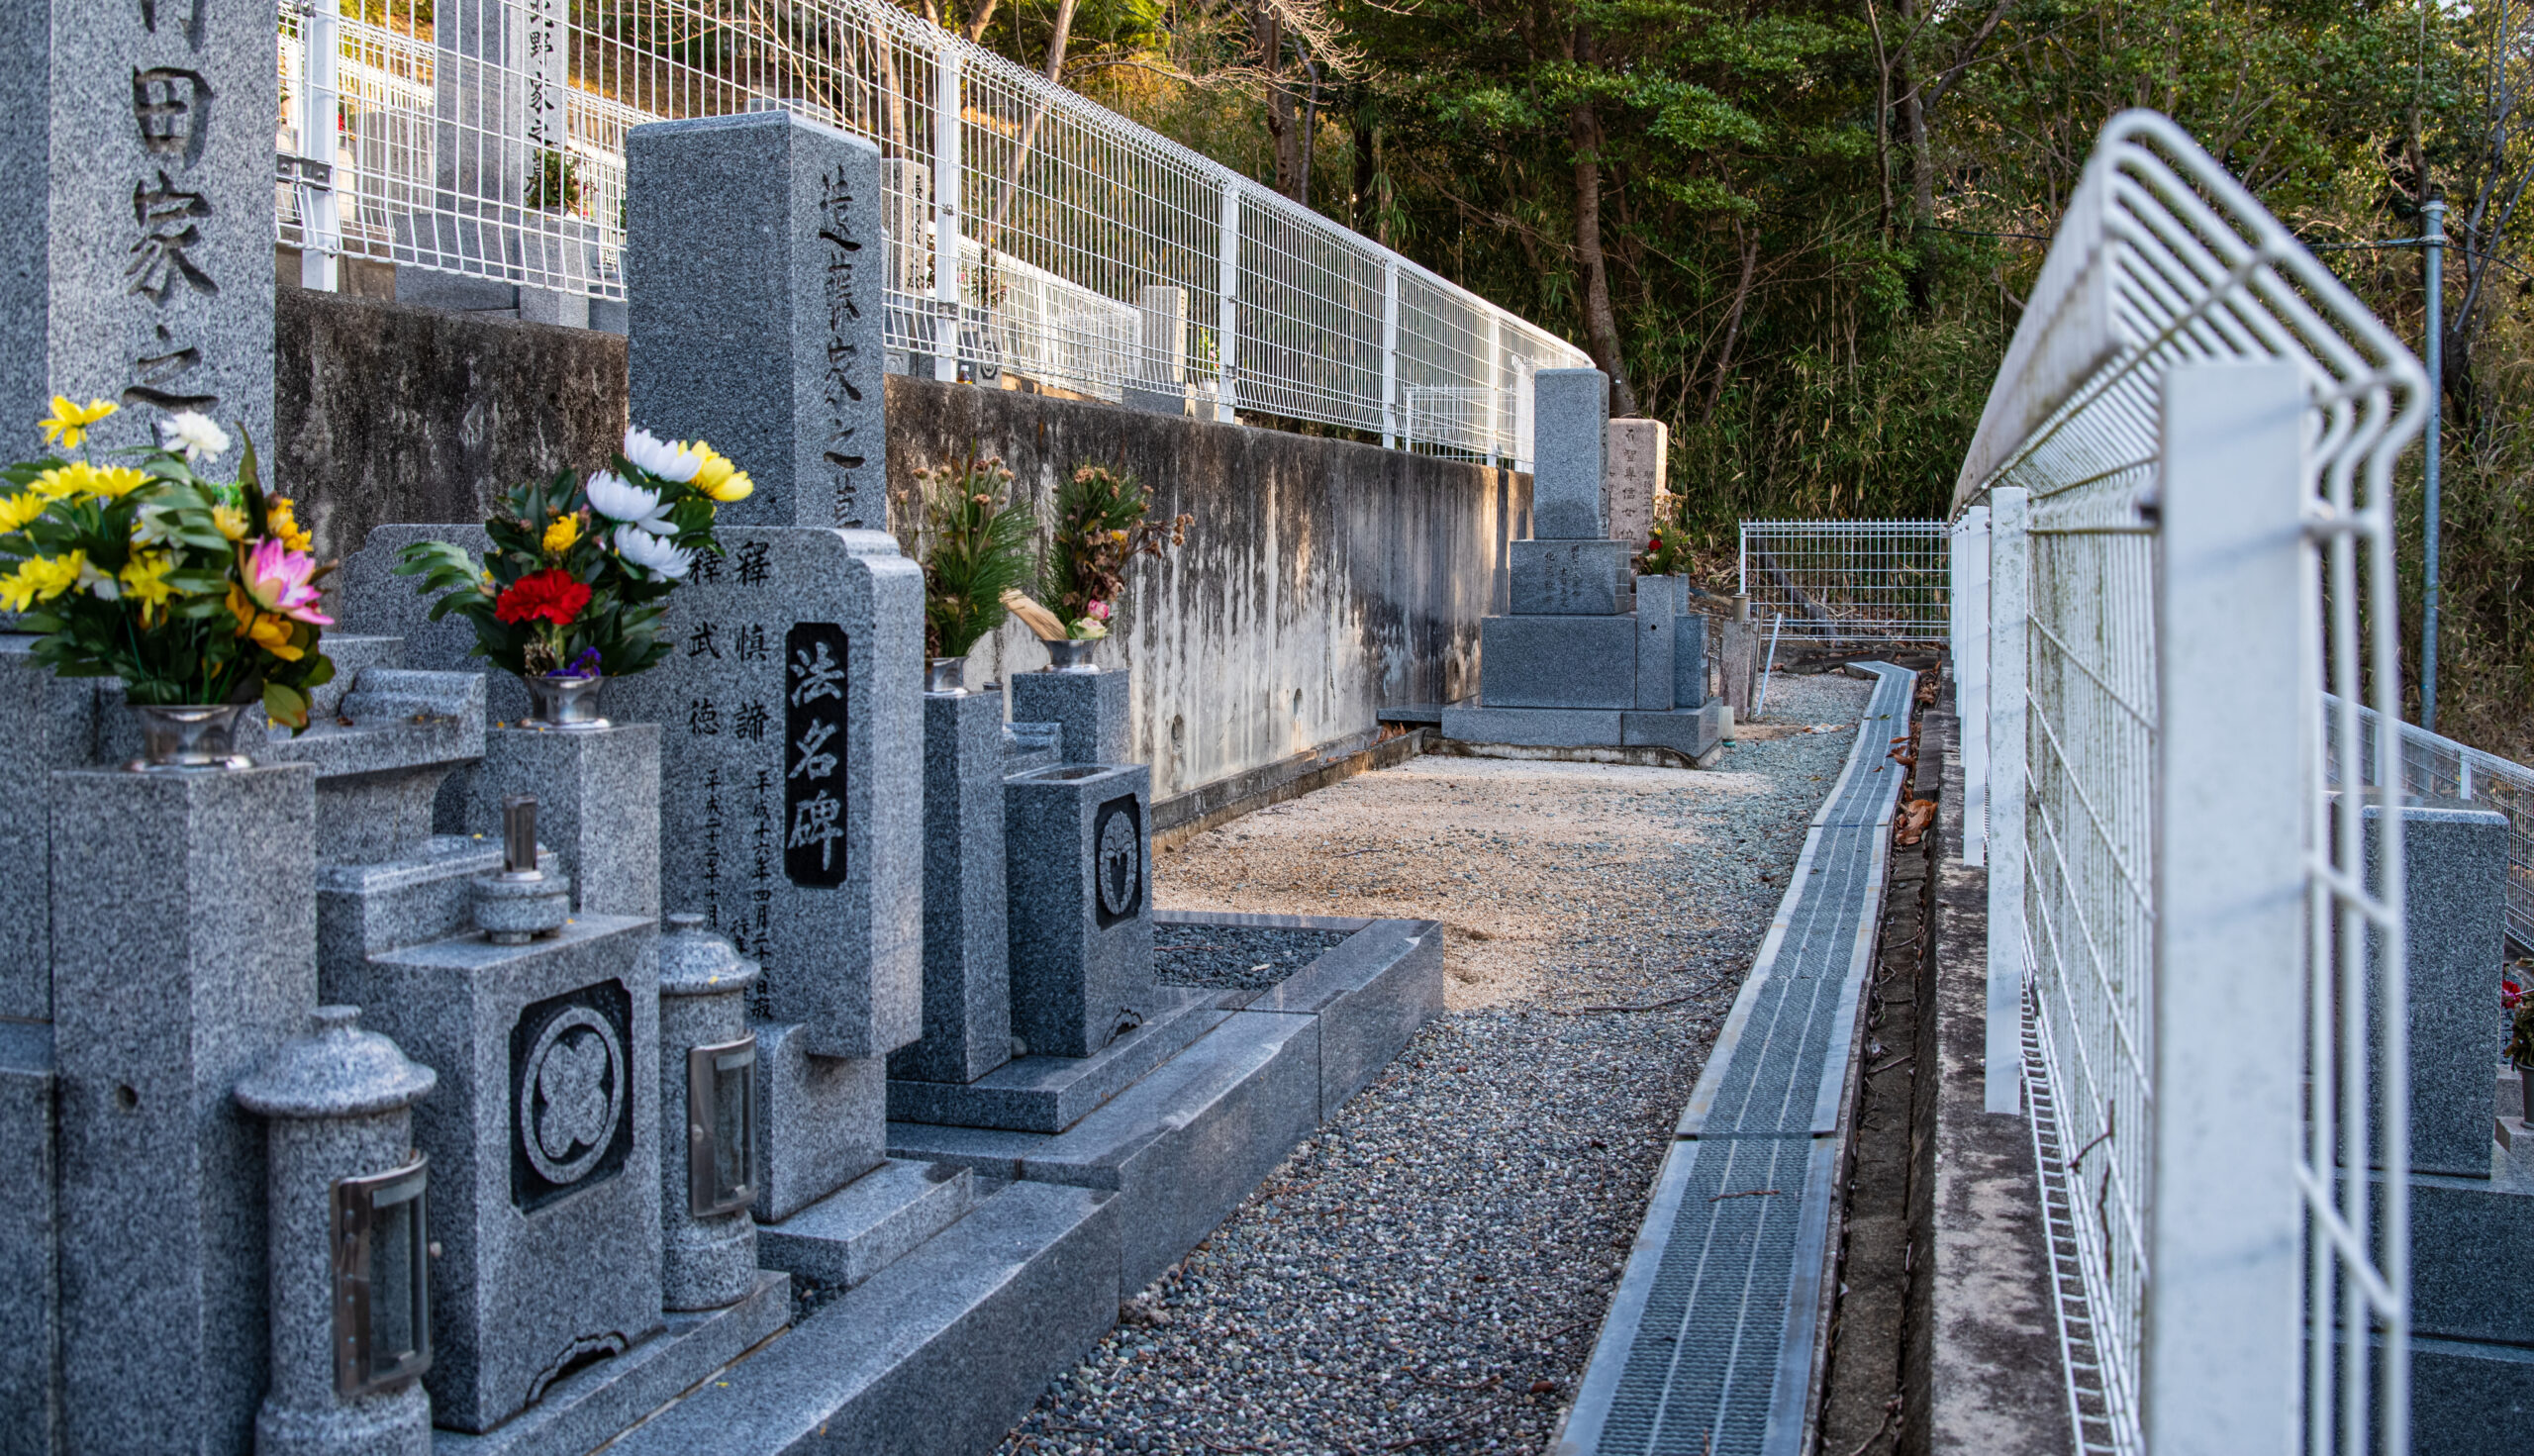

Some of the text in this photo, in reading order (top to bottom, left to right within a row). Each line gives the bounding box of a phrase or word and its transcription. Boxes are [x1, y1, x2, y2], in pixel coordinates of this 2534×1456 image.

[124, 0, 220, 447] 田家之
[788, 640, 845, 872] 法名碑
